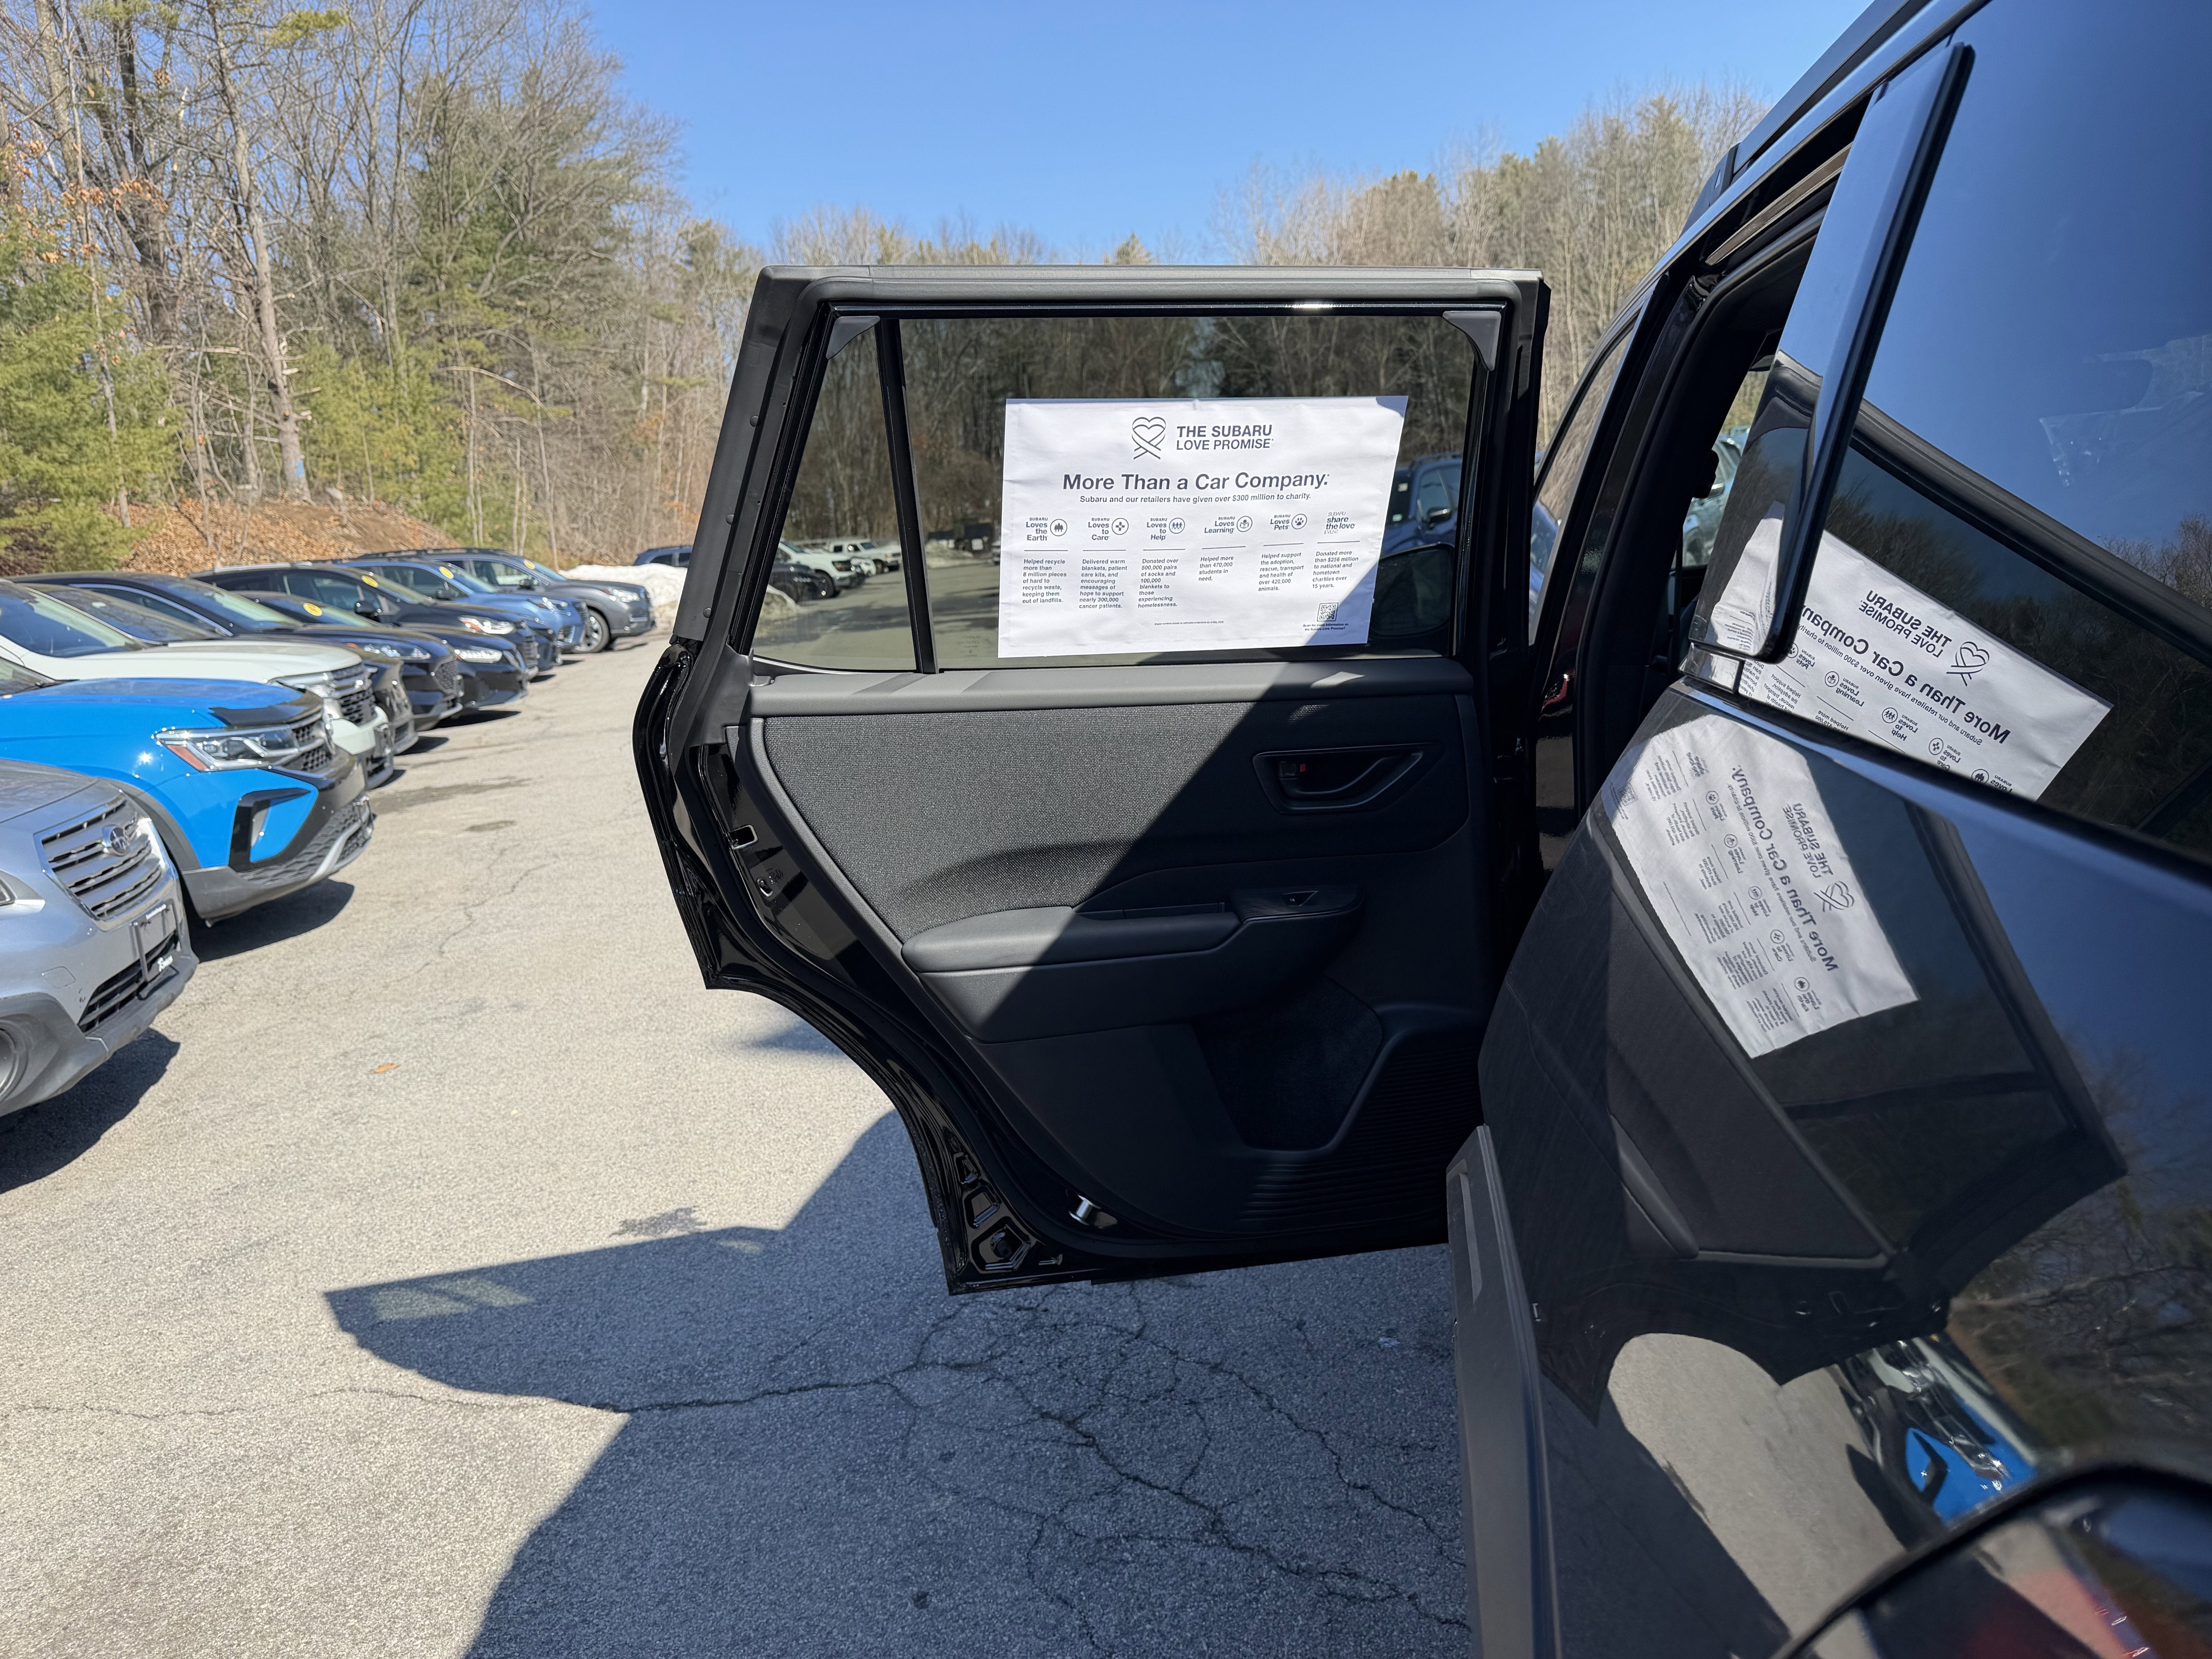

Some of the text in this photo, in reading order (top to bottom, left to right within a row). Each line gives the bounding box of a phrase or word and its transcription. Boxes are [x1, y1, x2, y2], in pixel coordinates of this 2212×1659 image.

[1177, 424, 1272, 438] THE SUBARU
[1176, 440, 1210, 450] LOVE
[1063, 474, 1114, 489] More
[1121, 474, 1170, 490] Than
[1177, 478, 1188, 490] a
[1195, 474, 1230, 490] Car
